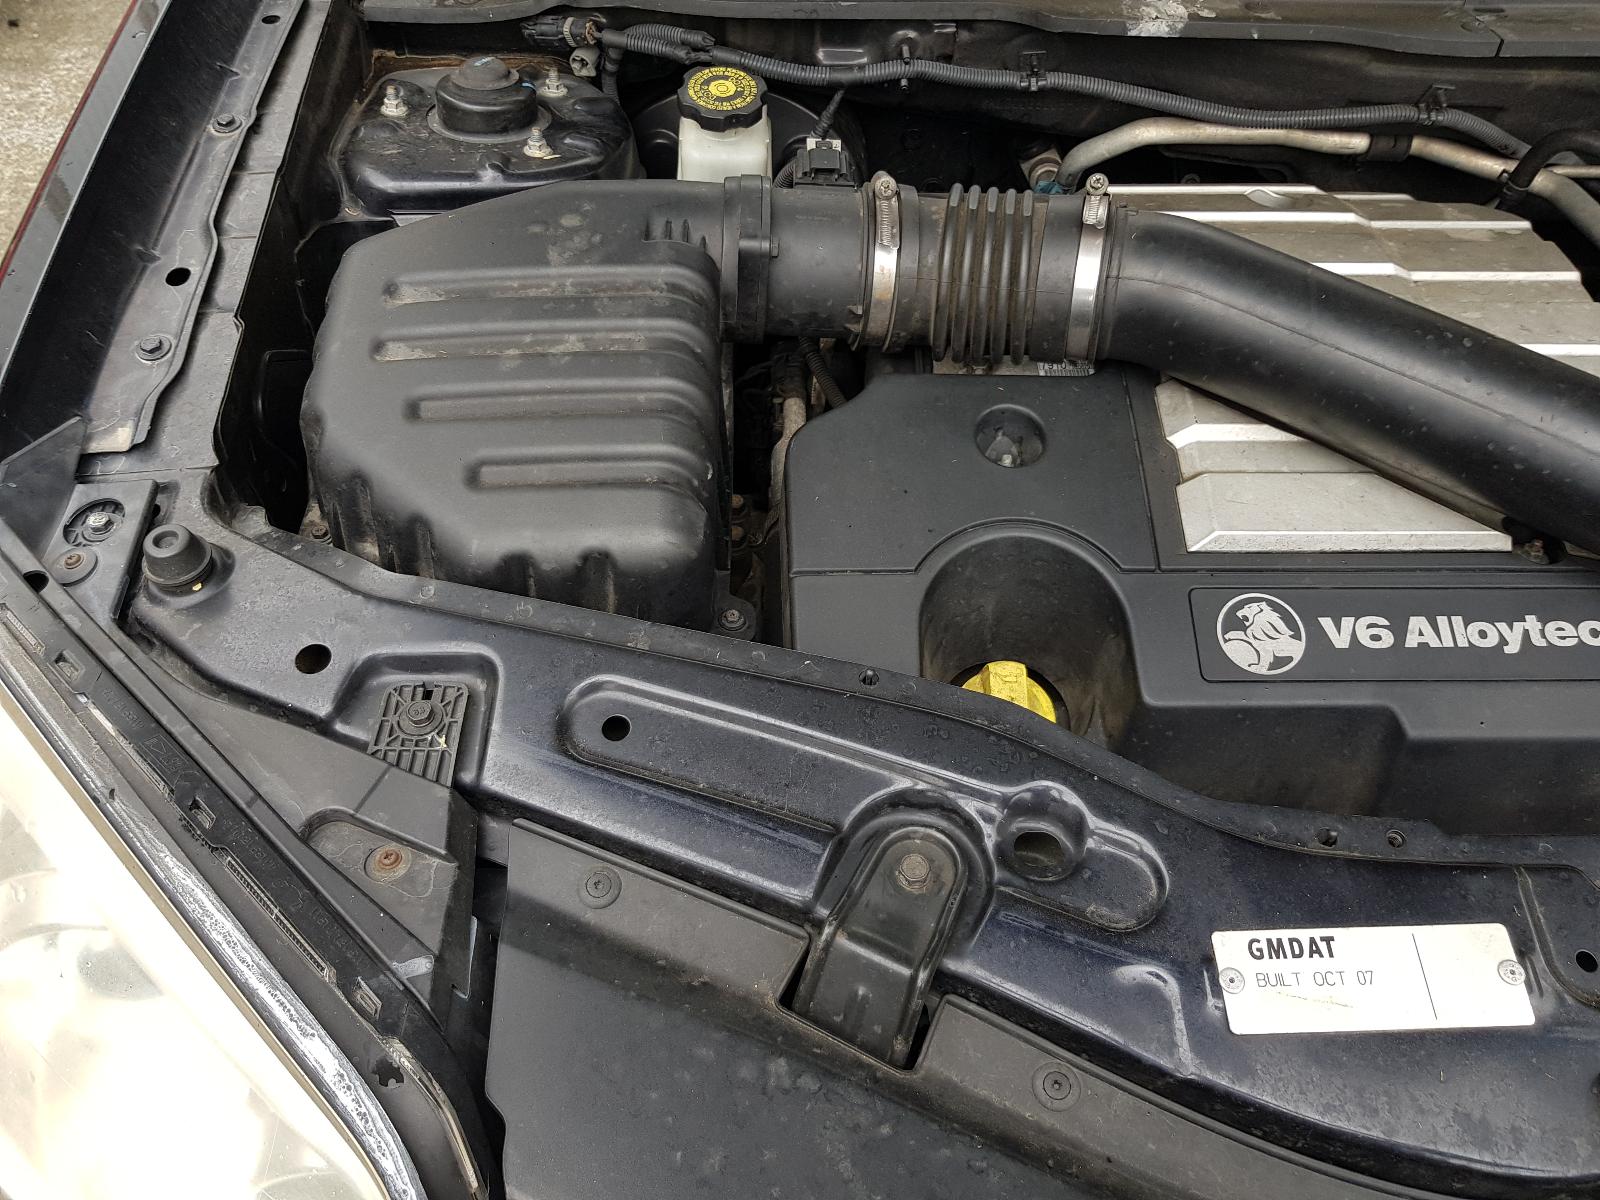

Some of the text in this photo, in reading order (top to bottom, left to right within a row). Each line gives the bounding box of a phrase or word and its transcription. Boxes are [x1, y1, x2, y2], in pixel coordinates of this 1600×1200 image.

[1317, 614, 1600, 654] V6 Alloytec
[1247, 936, 1336, 960] GMDAT
[1255, 971, 1301, 988] BUILT
[1313, 970, 1346, 987] OCT
[1356, 970, 1374, 986] 07
